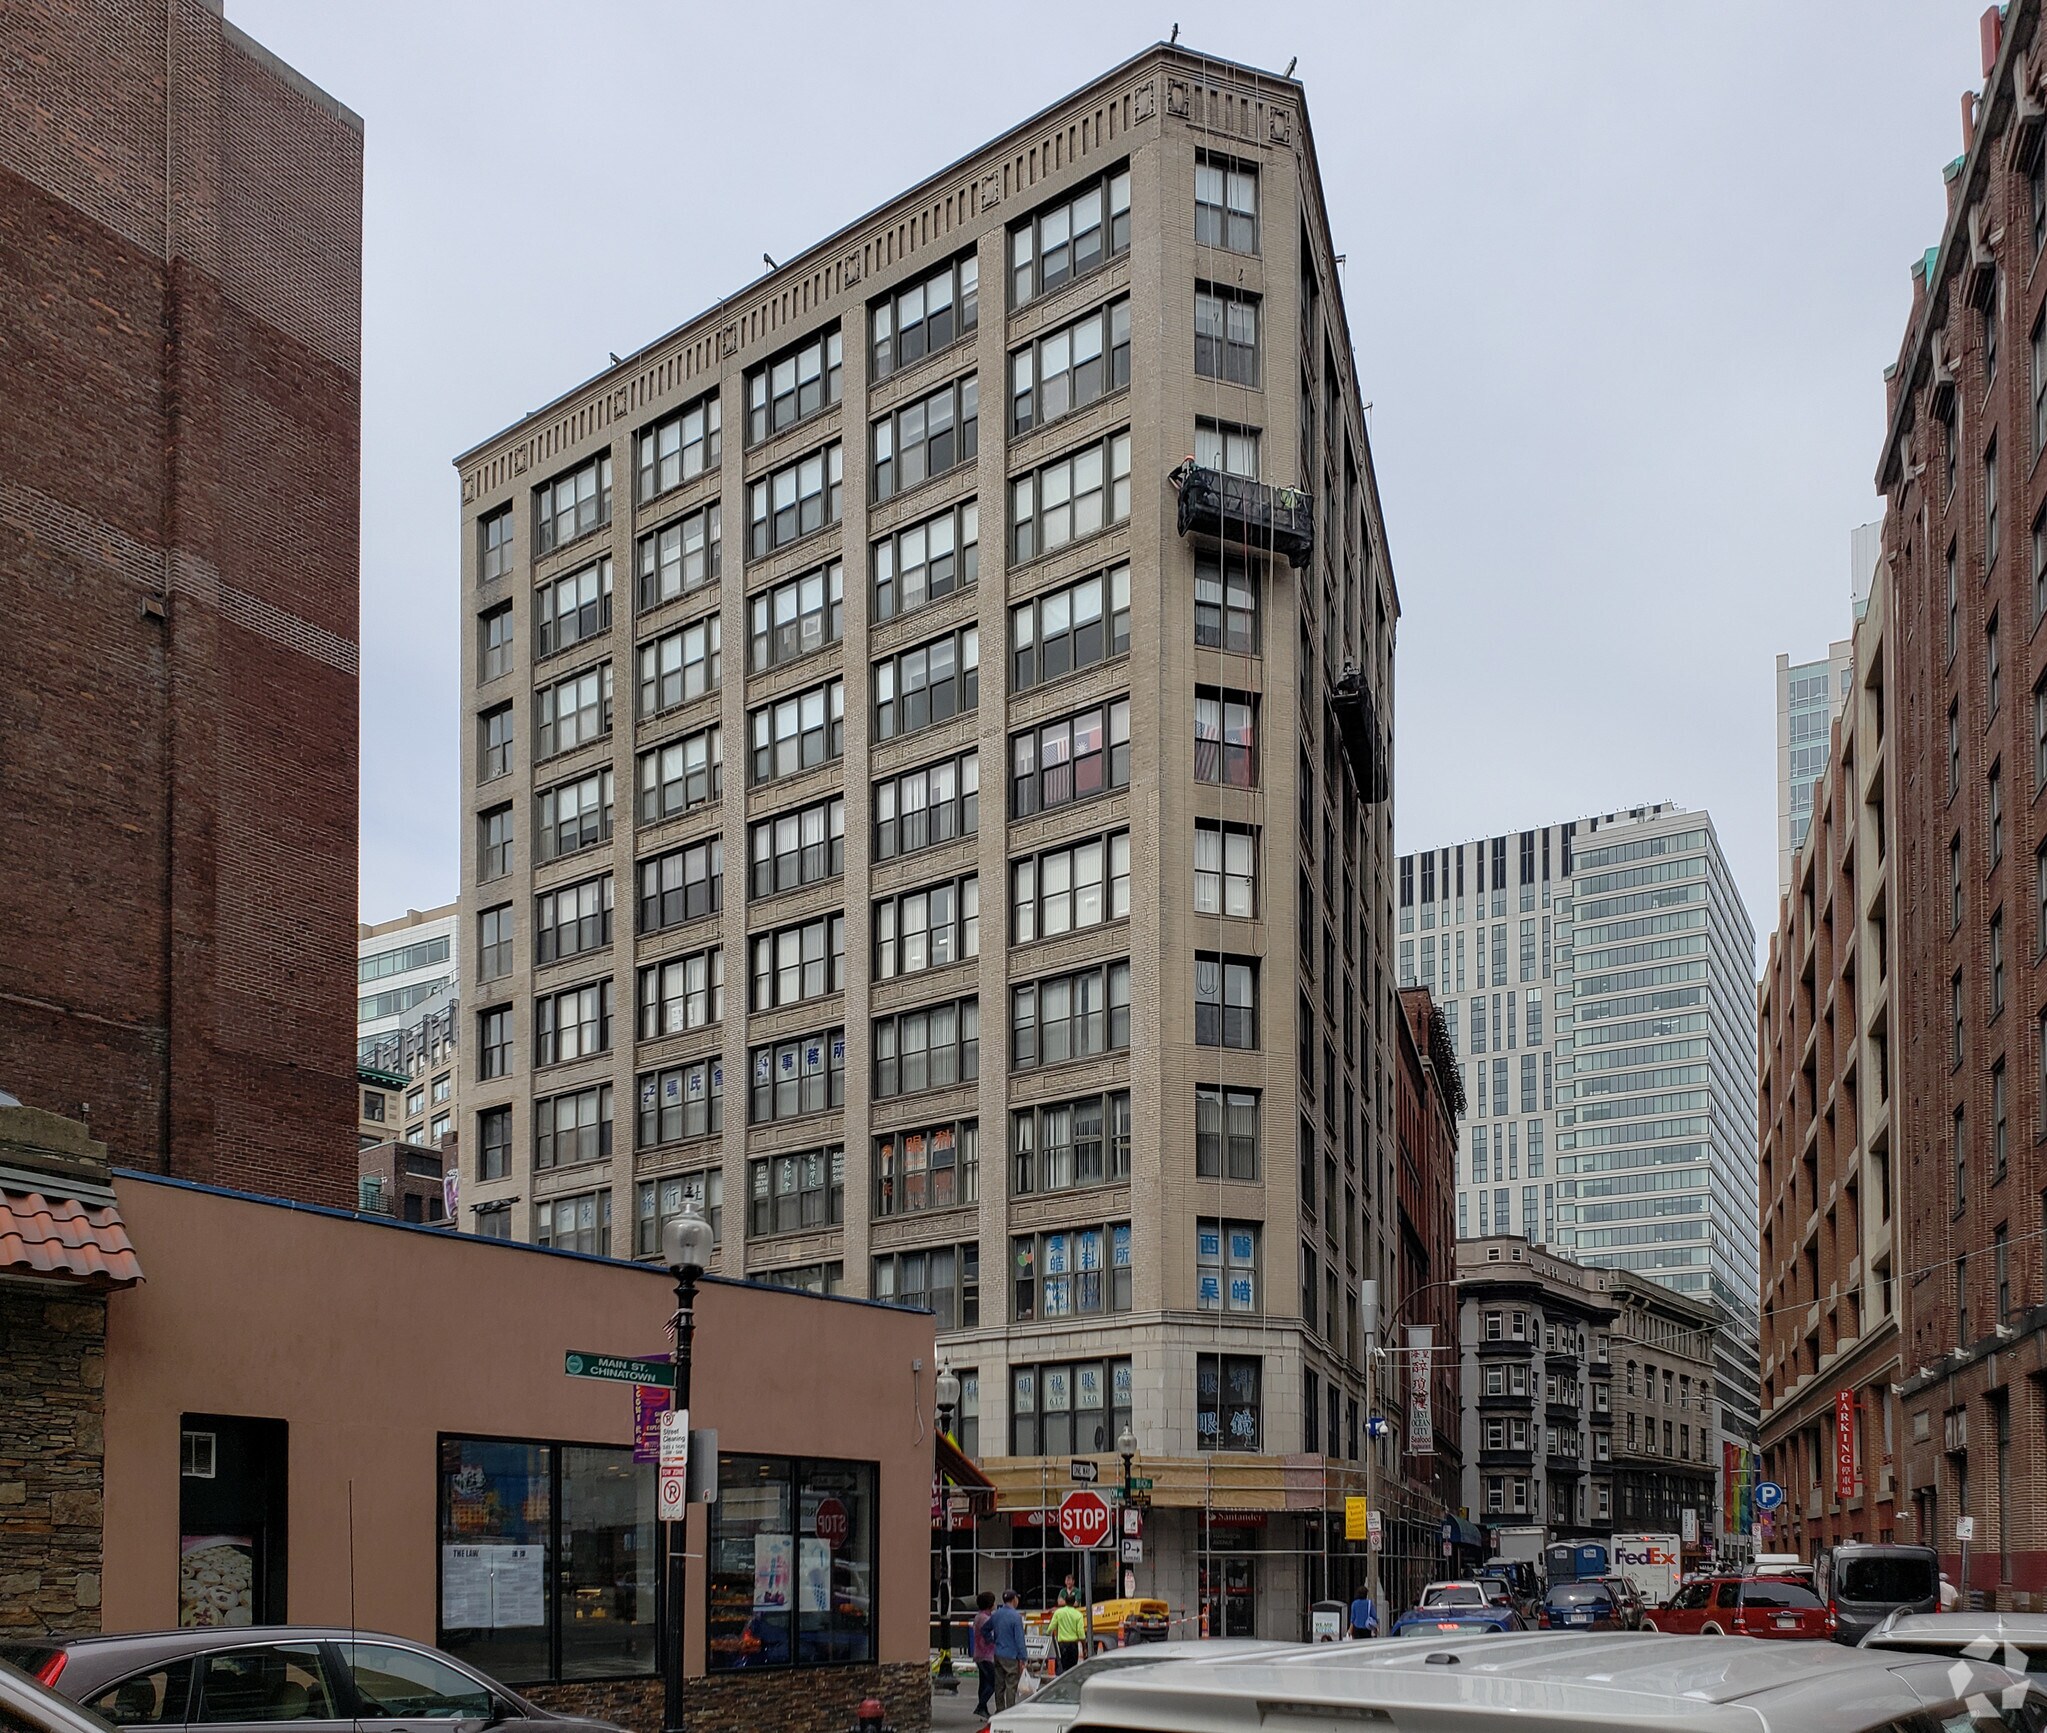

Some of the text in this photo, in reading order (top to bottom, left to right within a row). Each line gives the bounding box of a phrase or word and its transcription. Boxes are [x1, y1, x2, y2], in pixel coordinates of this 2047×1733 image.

[598, 1358, 627, 1369] MAIN
[590, 1366, 656, 1382] CHINATOWN
[1049, 1397, 1064, 1405] 617
[1082, 1395, 1097, 1404] 350
[1840, 1392, 1851, 1464] PARKING
[1762, 1486, 1776, 1503] P
[1063, 1508, 1105, 1530] STOP
[1218, 1513, 1262, 1521] Santander
[1615, 1547, 1676, 1565] FedEx
